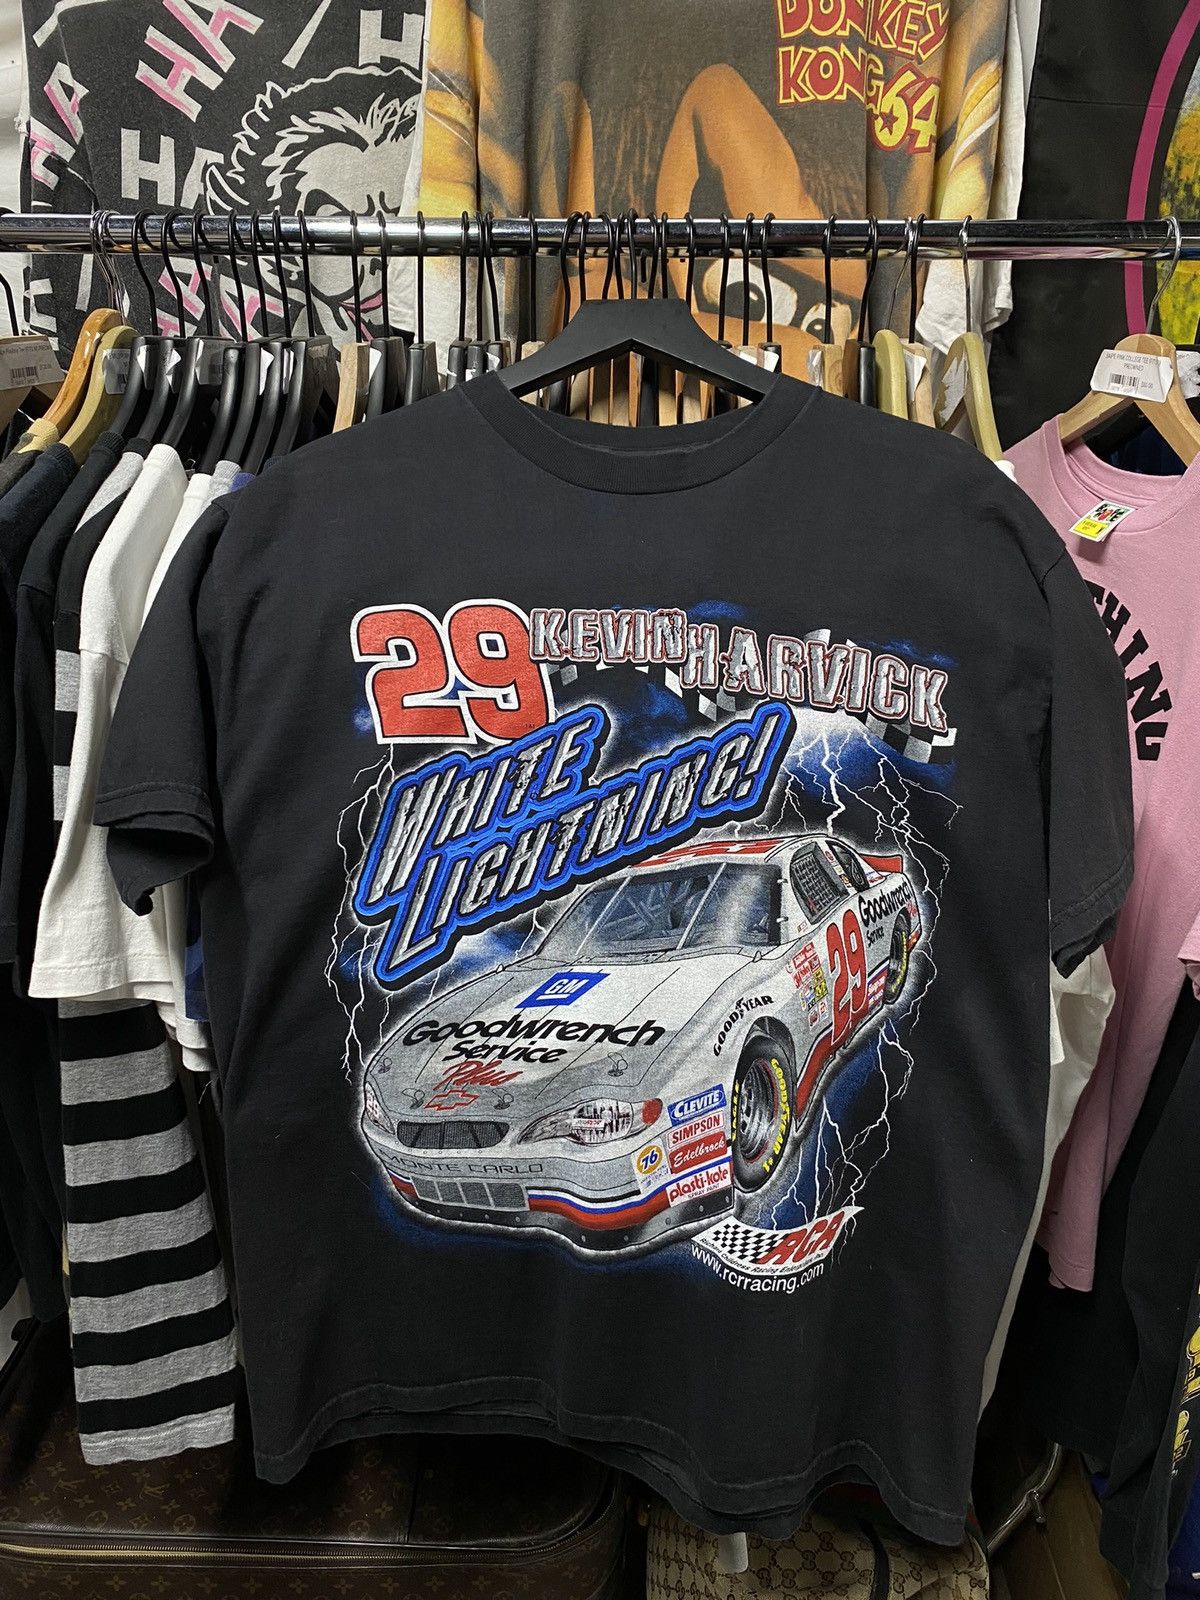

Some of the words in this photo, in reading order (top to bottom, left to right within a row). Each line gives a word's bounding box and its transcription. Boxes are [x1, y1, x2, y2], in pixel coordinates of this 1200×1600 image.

[777, 0, 949, 62] DONKEY
[778, 42, 885, 115] KONG
[869, 63, 941, 154] 64
[351, 598, 549, 745] 29
[529, 607, 687, 665] KEVIN
[679, 624, 950, 733] HARVICK
[1084, 579, 1172, 761] HING
[372, 714, 597, 906] WHITE
[386, 712, 784, 974] LIGHTNING!
[549, 976, 589, 998] GM
[825, 908, 869, 1046] 29
[402, 1014, 666, 1048] Goodwrench
[713, 995, 774, 1057] GOODYEAR
[442, 1039, 568, 1064] Service
[432, 1059, 524, 1091] Plus
[673, 1089, 720, 1119] CLEVITE
[671, 1114, 721, 1145] SIMPSON
[379, 1149, 461, 1172] MONTE
[468, 1163, 544, 1174] CARLO
[641, 1149, 659, 1171] 76
[673, 1136, 726, 1169] Edelbrock
[669, 1165, 729, 1203] plasti-kote
[756, 1210, 845, 1265] RCR
[690, 1244, 825, 1294] www.rcrracing.com
